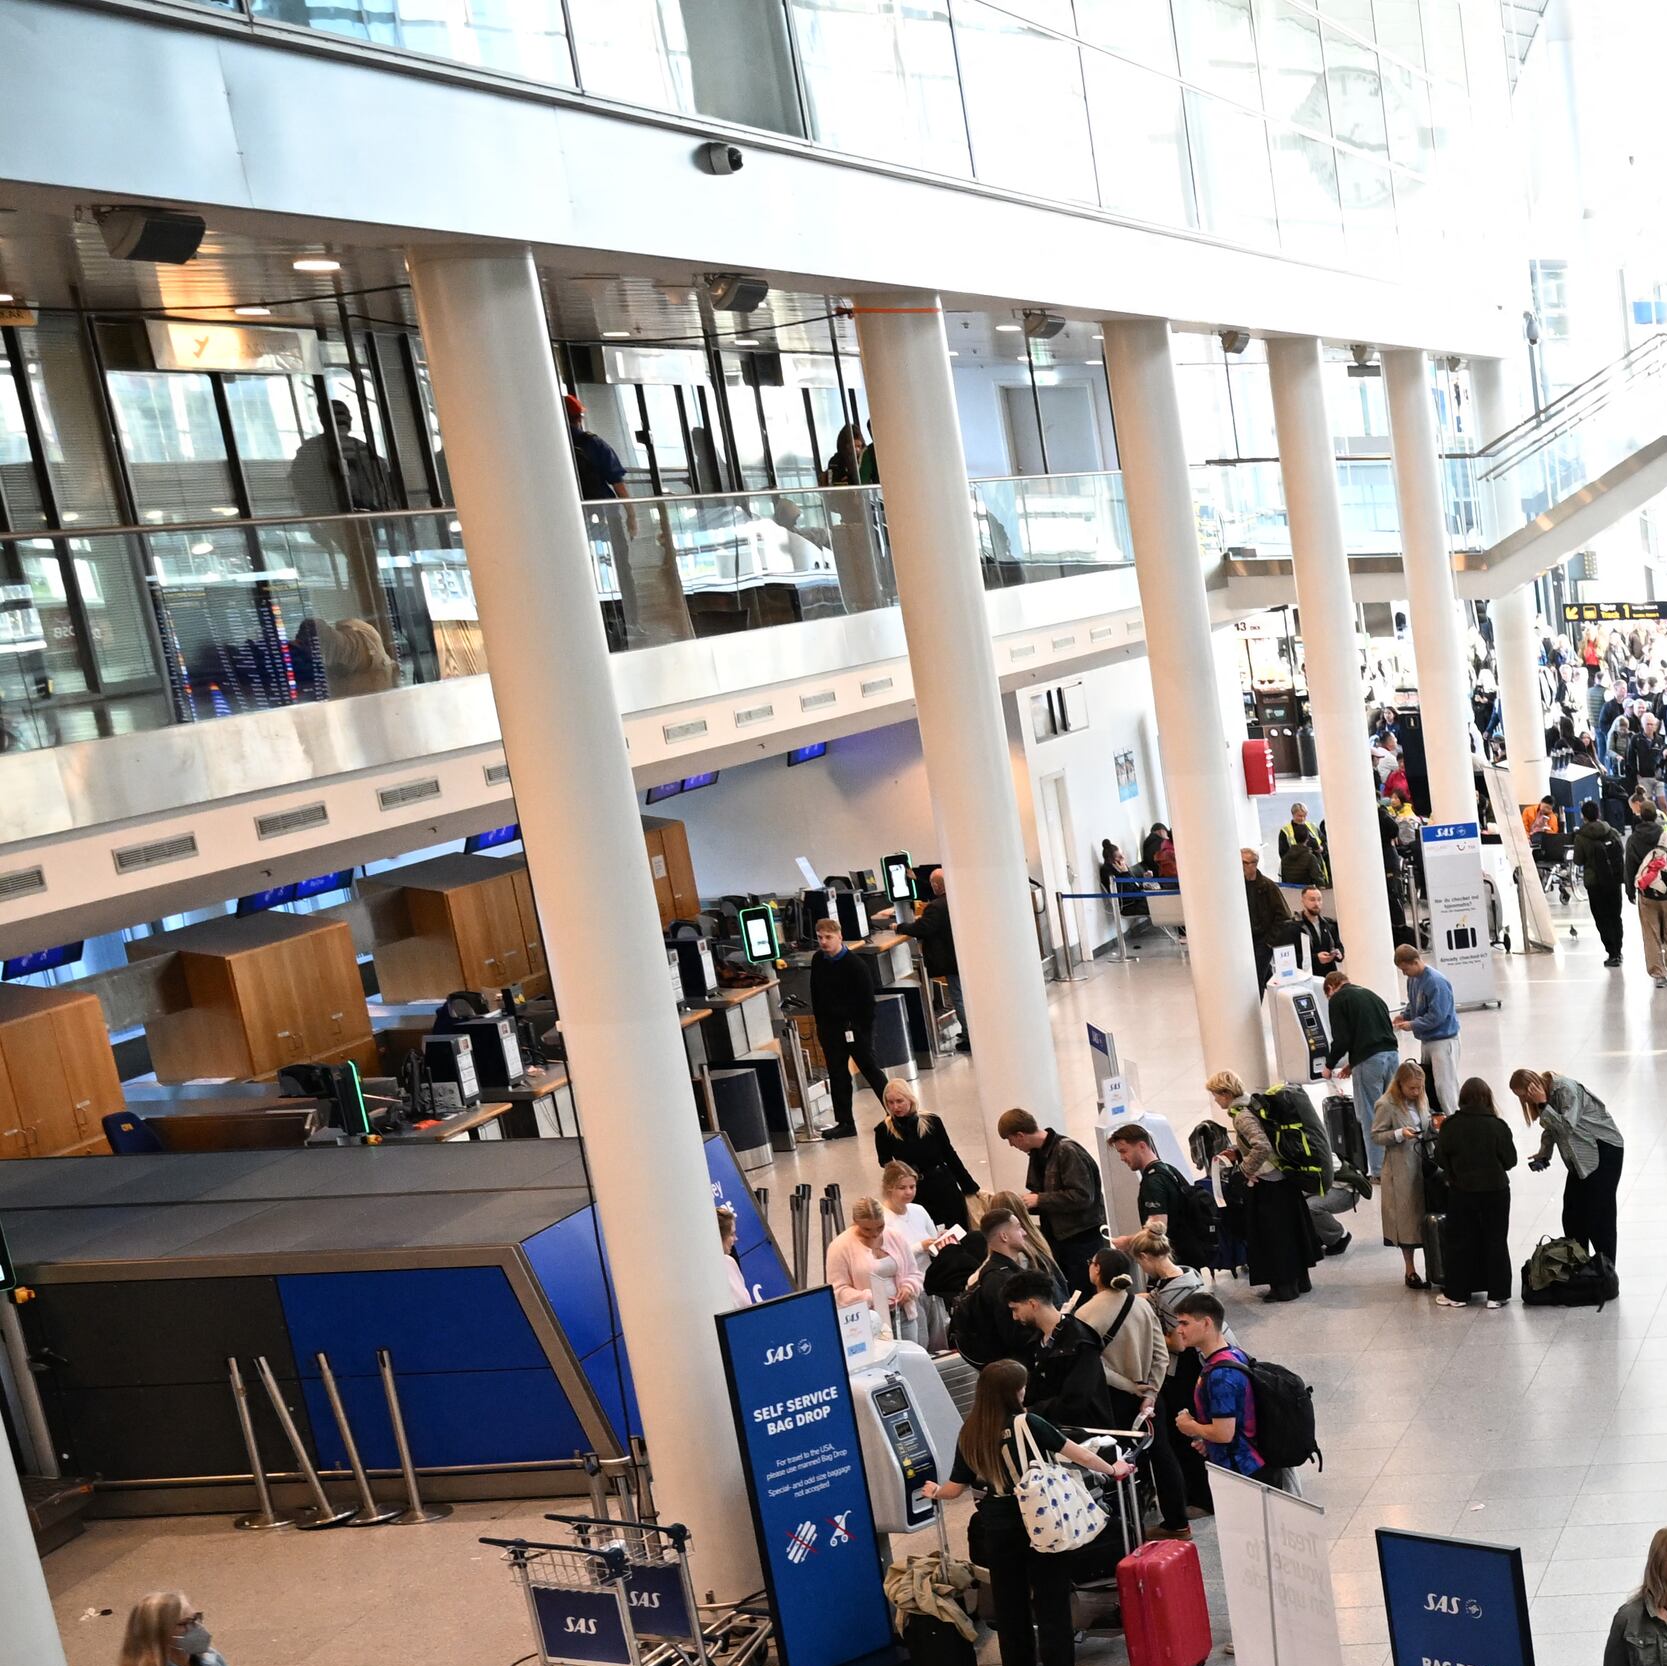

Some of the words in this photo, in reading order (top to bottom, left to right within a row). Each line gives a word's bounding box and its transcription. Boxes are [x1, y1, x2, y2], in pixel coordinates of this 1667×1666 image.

[1622, 604, 1630, 619] 1
[1234, 622, 1247, 631] 13
[1435, 827, 1456, 838] SAS
[844, 1312, 860, 1325] SAS
[763, 1343, 794, 1366] SAS
[753, 1402, 785, 1423] SELF
[786, 1386, 839, 1413] SERVICE
[766, 1416, 794, 1436] BAG
[796, 1405, 832, 1427] DROP
[766, 1468, 786, 1481] please
[797, 1457, 821, 1471] manned
[832, 1448, 848, 1462] Drop
[786, 1452, 803, 1464] travel
[767, 1483, 793, 1498] Special-
[827, 1464, 852, 1479] baggage
[804, 1481, 831, 1495] accepted
[628, 1590, 662, 1609] SAS
[1424, 1593, 1461, 1615] SAS
[563, 1616, 598, 1635] SAS
